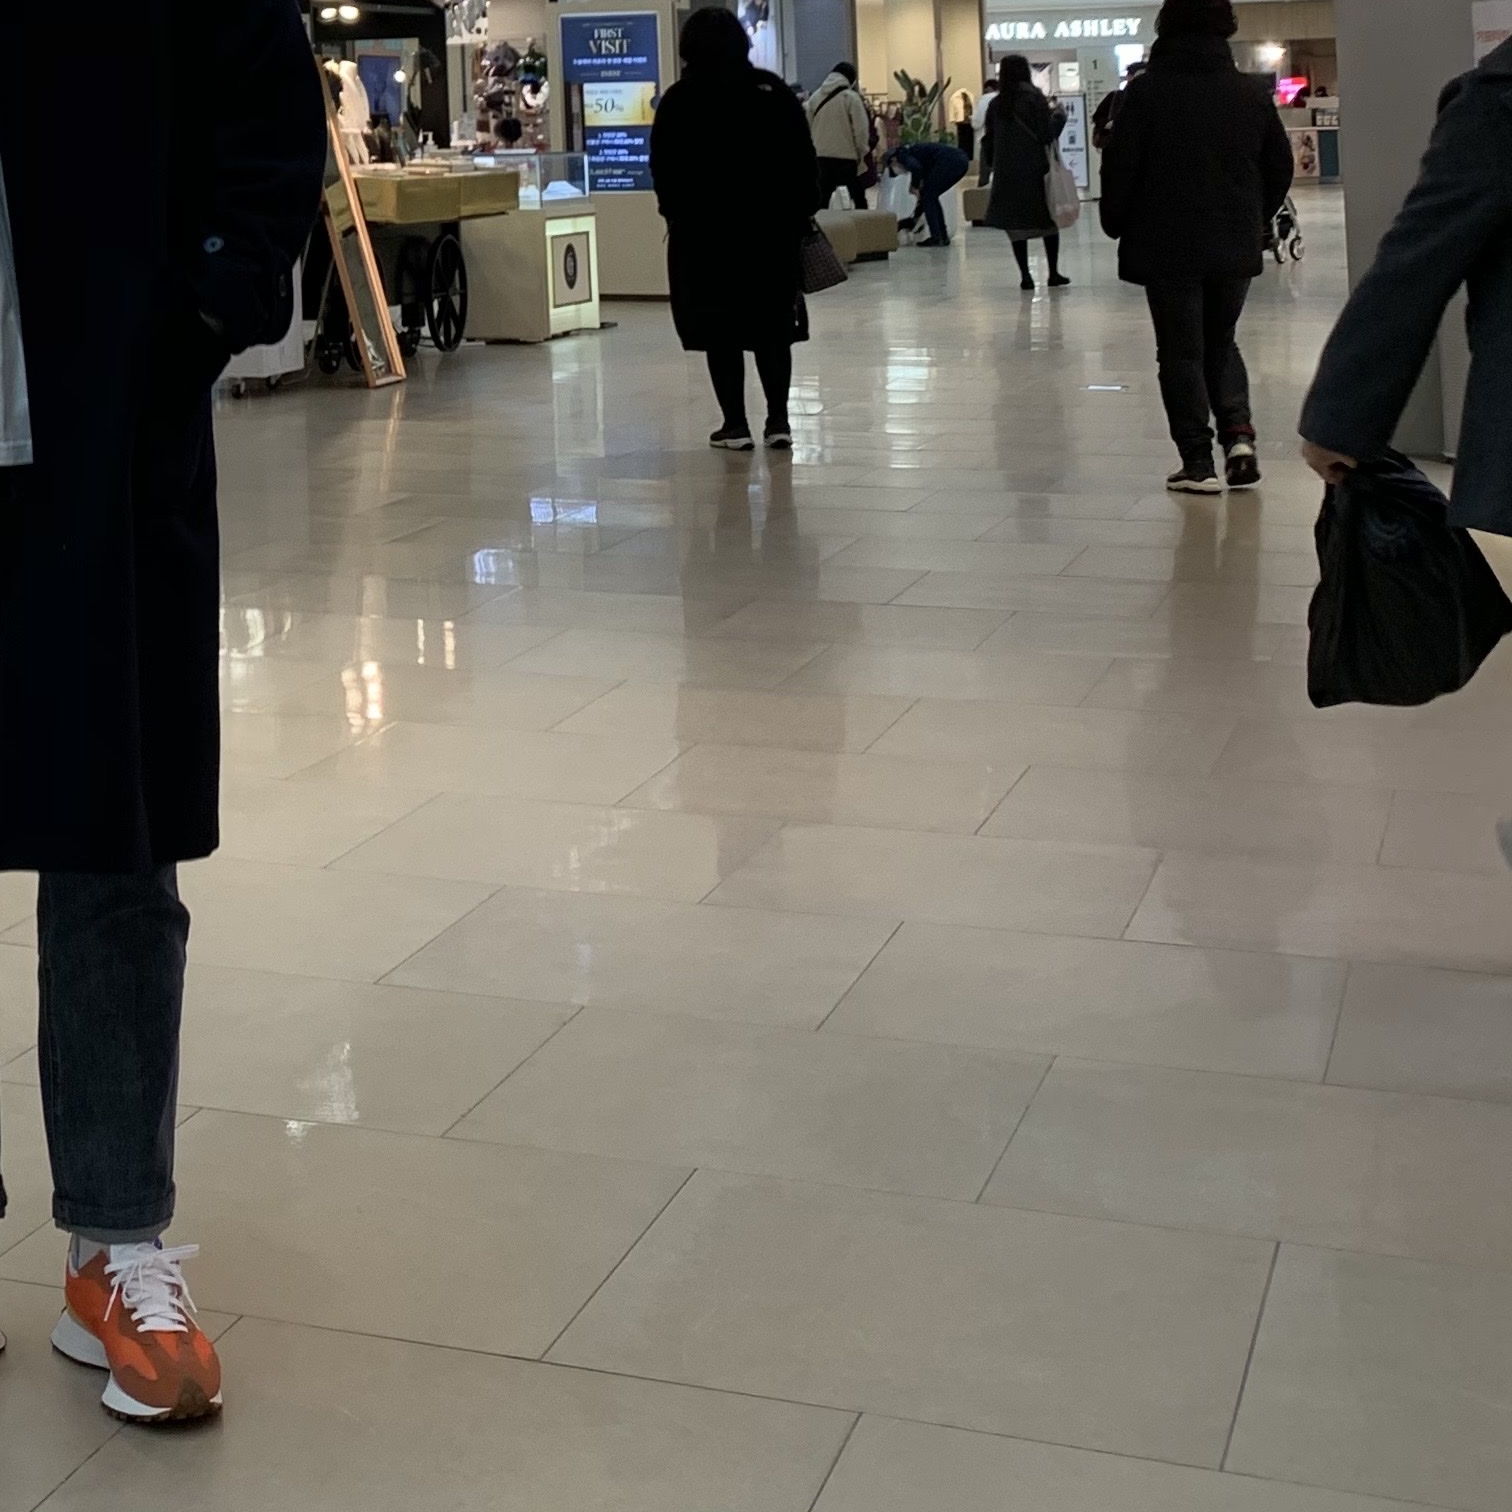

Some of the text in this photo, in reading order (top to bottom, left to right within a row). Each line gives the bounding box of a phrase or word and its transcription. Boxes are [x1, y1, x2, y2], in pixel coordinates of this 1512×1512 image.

[594, 28, 624, 39] FIRST
[1054, 17, 1142, 38] ASHLEY
[589, 39, 631, 55] VISIT
